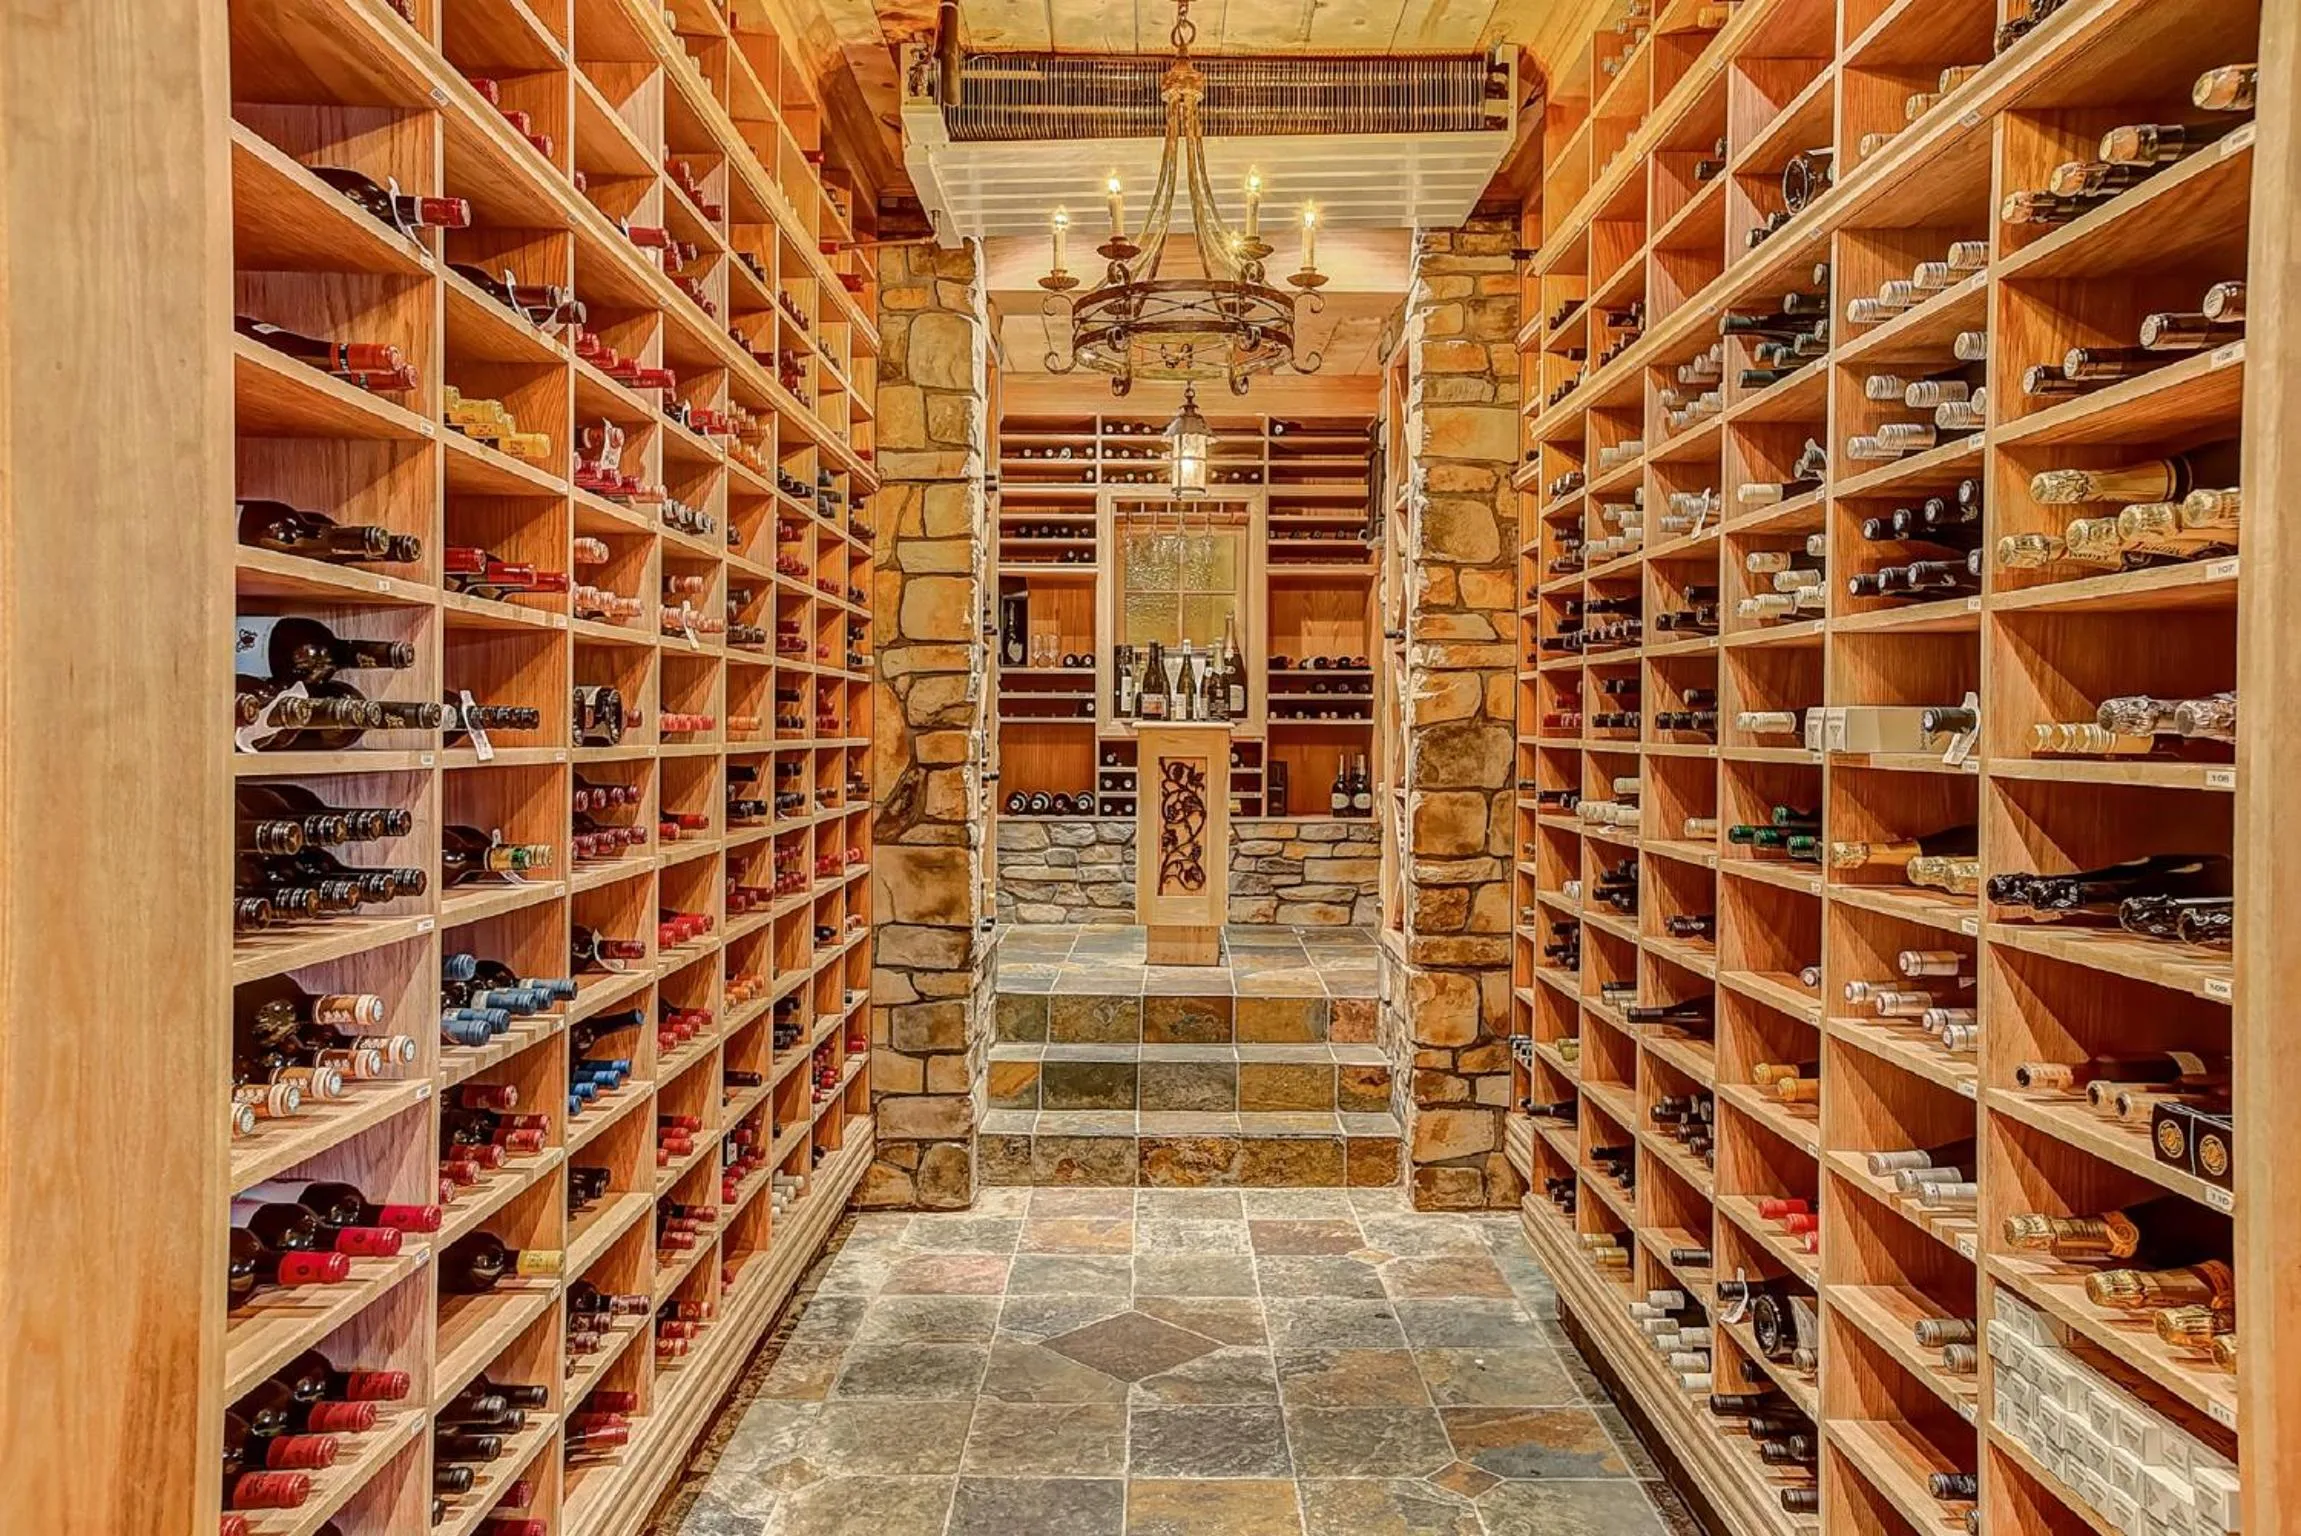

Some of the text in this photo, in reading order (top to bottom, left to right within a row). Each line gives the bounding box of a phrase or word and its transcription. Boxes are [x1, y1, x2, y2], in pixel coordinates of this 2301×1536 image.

[2217, 564, 2234, 574] 107
[2211, 774, 2230, 783] 108
[2211, 1193, 2230, 1205] 110
